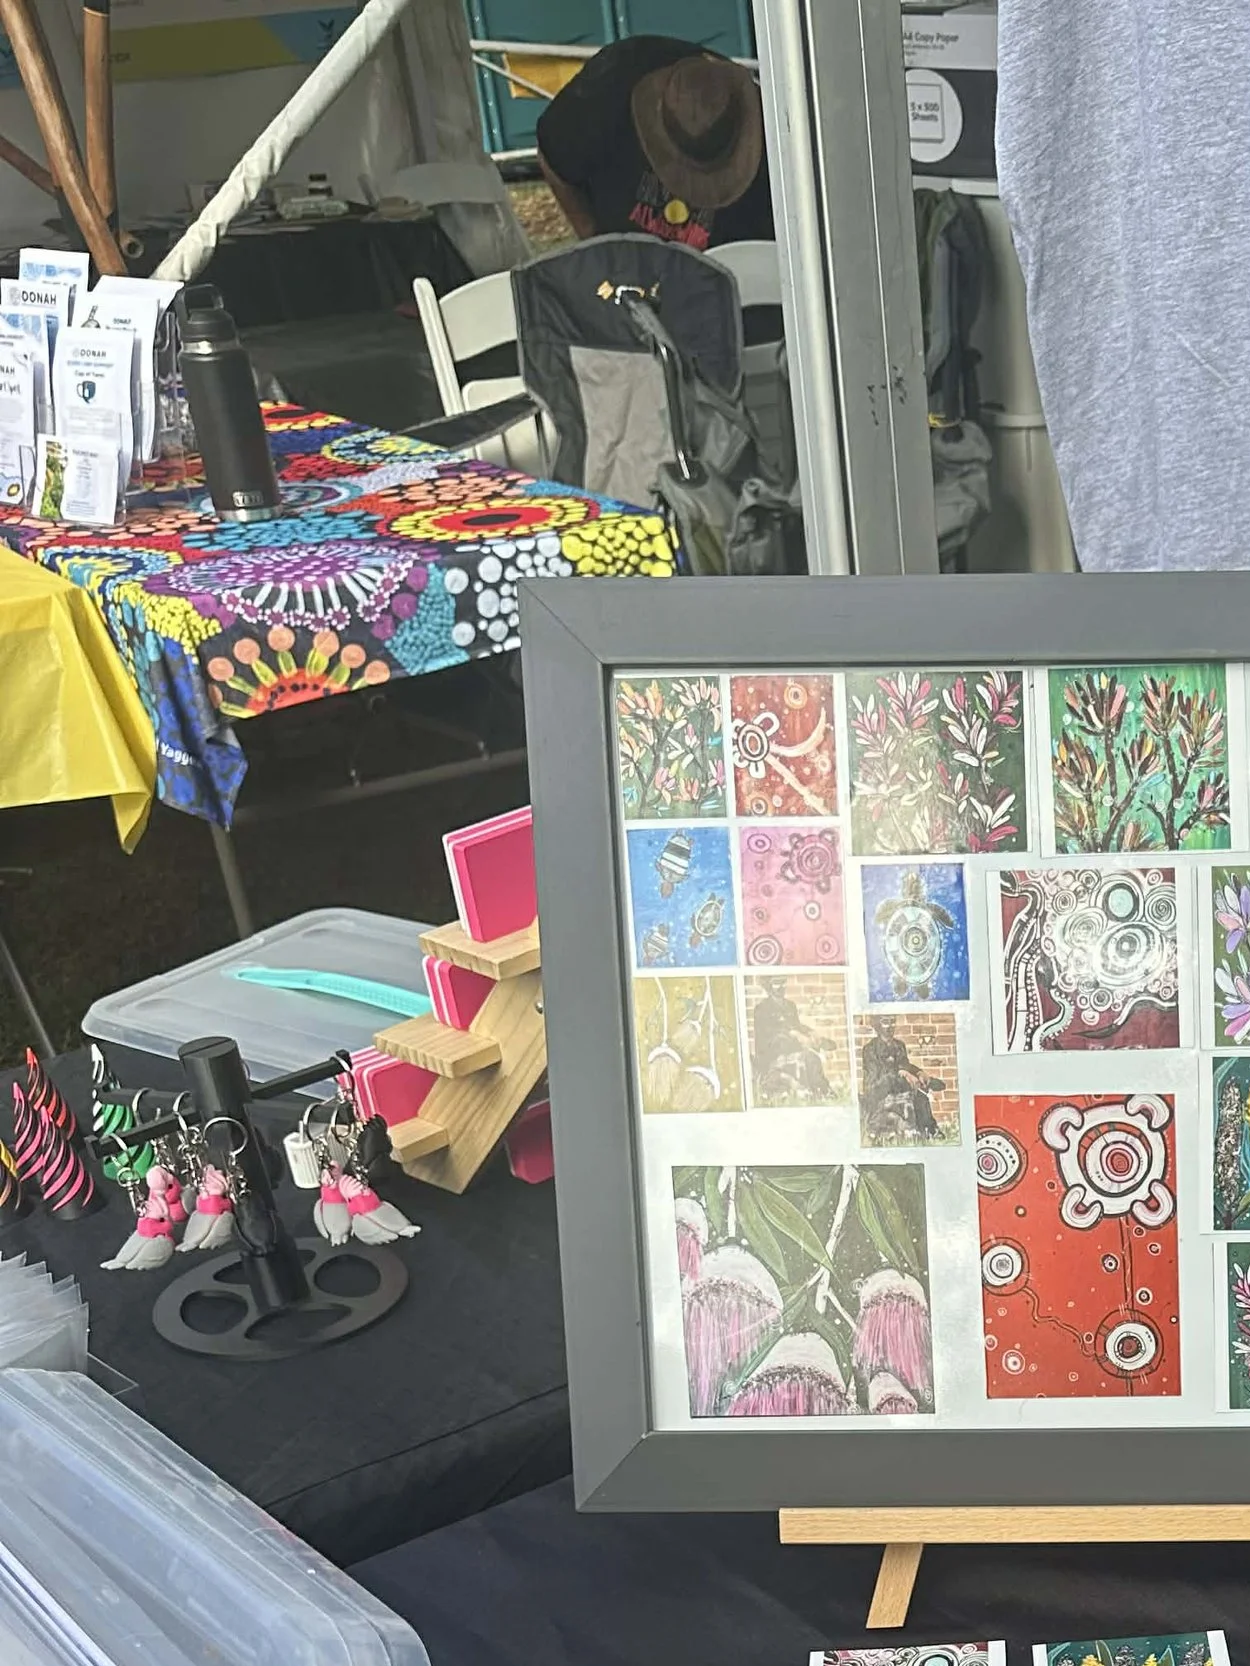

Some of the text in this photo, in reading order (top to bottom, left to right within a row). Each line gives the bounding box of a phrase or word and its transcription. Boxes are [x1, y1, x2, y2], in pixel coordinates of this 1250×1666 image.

[914, 32, 934, 42] Copy
[936, 33, 959, 44] Paper
[910, 103, 917, 111] 5
[923, 103, 939, 111] 500
[911, 112, 939, 123] Sheets
[21, 290, 57, 306] DONAH
[80, 348, 107, 359] DONAH
